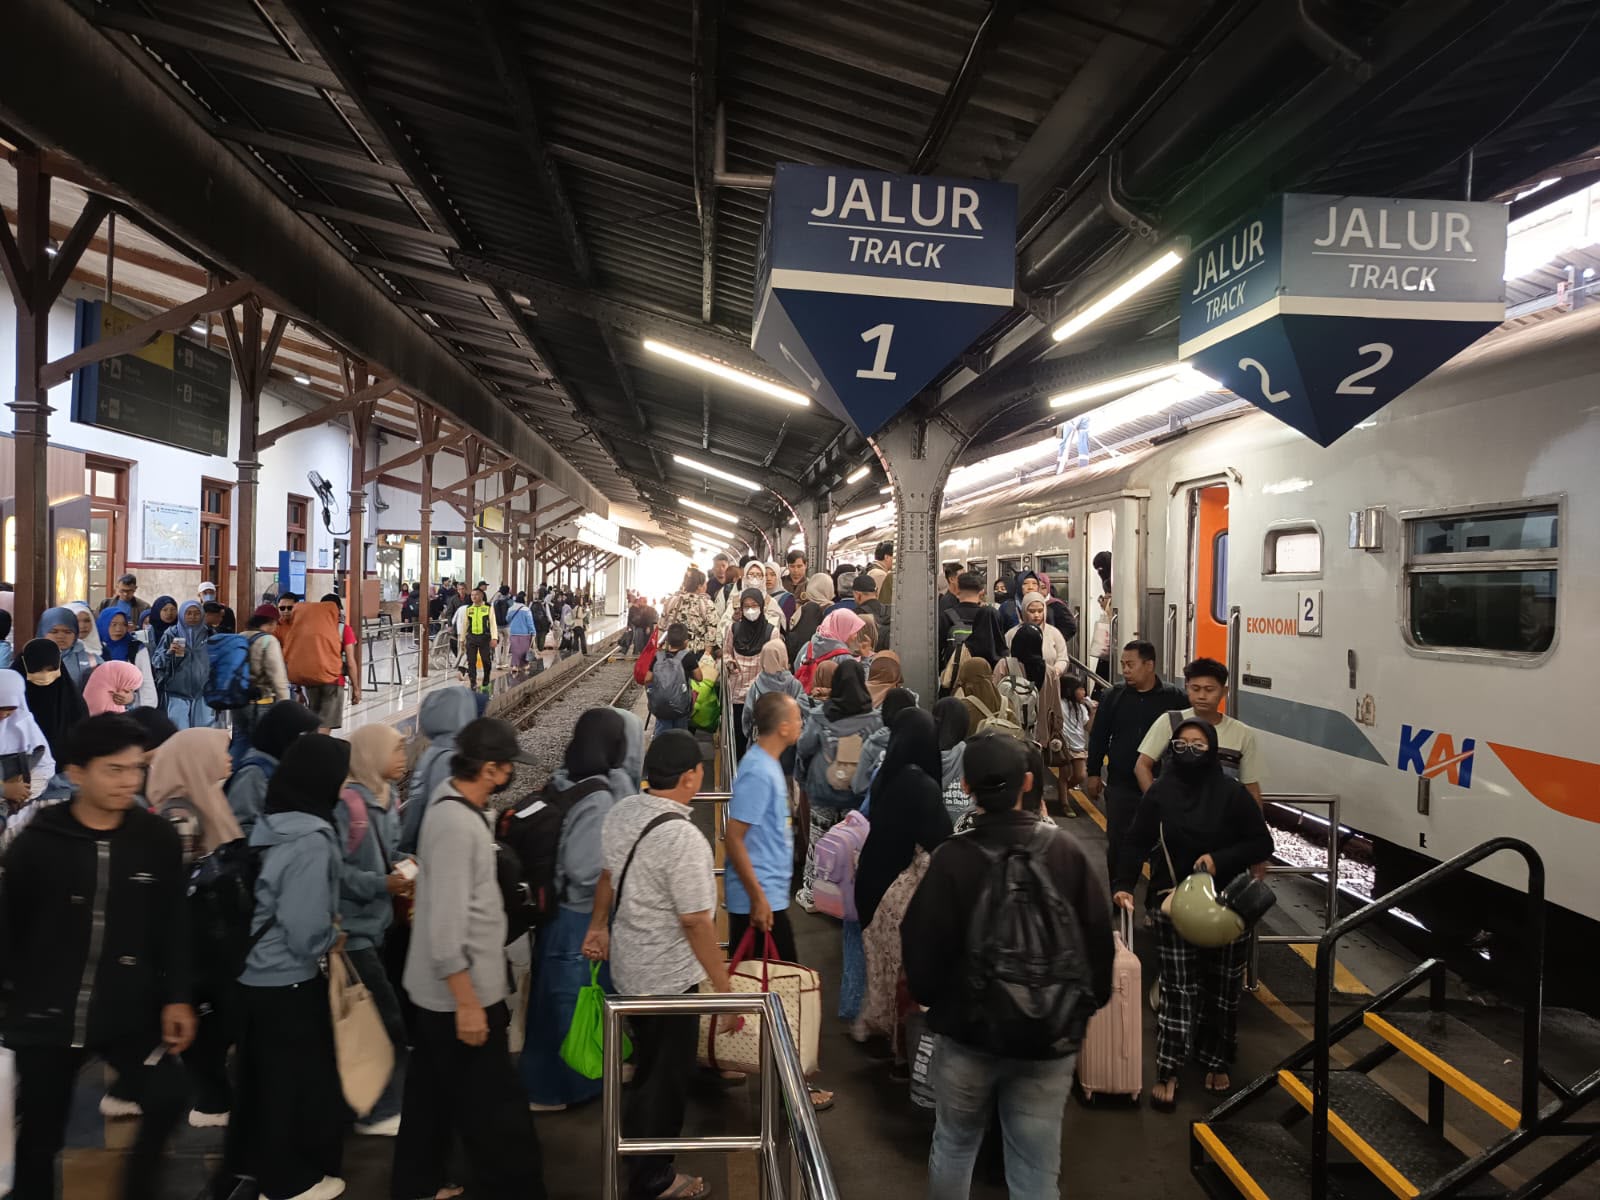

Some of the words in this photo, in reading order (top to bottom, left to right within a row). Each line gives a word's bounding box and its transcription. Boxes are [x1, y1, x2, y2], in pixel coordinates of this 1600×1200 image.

[811, 175, 983, 231] JALUR
[848, 236, 946, 269] TRACK
[1313, 206, 1474, 253] JALUR
[1192, 220, 1265, 295] JALUR
[1348, 263, 1439, 292] TRACK
[1205, 280, 1246, 324] TRACK
[856, 323, 897, 381] 1
[1335, 342, 1394, 395] 2
[1237, 357, 1291, 404] 2
[1246, 617, 1297, 636] EKONOMI
[1304, 597, 1314, 621] 2
[1397, 724, 1476, 789] KAI
